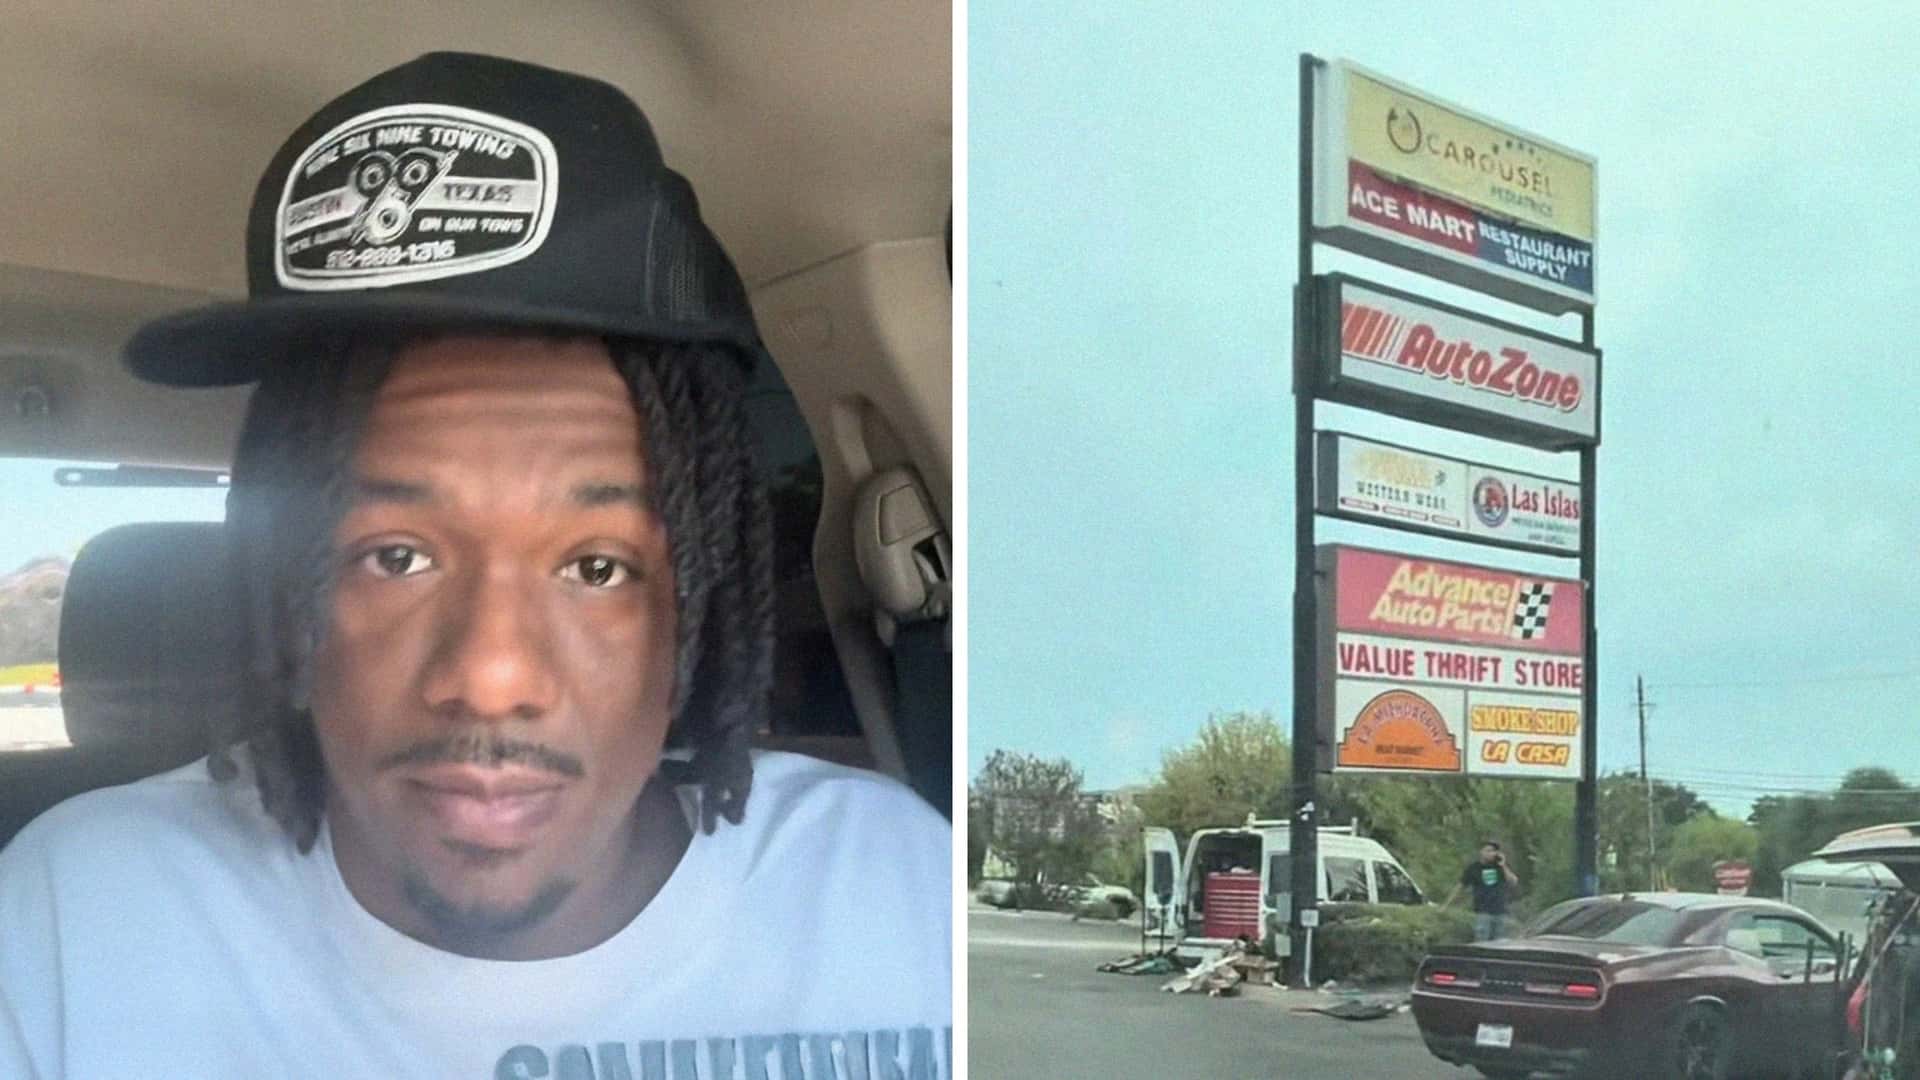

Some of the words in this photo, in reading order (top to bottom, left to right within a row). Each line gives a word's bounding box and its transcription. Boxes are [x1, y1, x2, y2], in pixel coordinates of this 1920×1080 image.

[429, 127, 517, 160] TOWING
[1426, 132, 1553, 197] CAROUSEL
[1351, 184, 1401, 220] ACE
[1407, 203, 1476, 244] MART
[1478, 219, 1591, 269] RESTAURANT
[1505, 249, 1568, 281] SUPPLY
[1397, 324, 1581, 410] AutoZone
[1357, 481, 1410, 503] WESTERN
[1511, 483, 1539, 513] Las
[1543, 486, 1580, 520] Islas
[1388, 561, 1513, 607] Advance
[1369, 595, 1436, 626] Auto
[1436, 603, 1508, 633] Parts
[1339, 643, 1416, 677] VALUE
[1424, 651, 1502, 683] THRIFT
[1515, 658, 1583, 689] STORE
[1471, 705, 1534, 733] SMOKE
[1535, 708, 1578, 736] SHOP
[1481, 739, 1511, 763] LA
[1515, 741, 1570, 768] CASA
